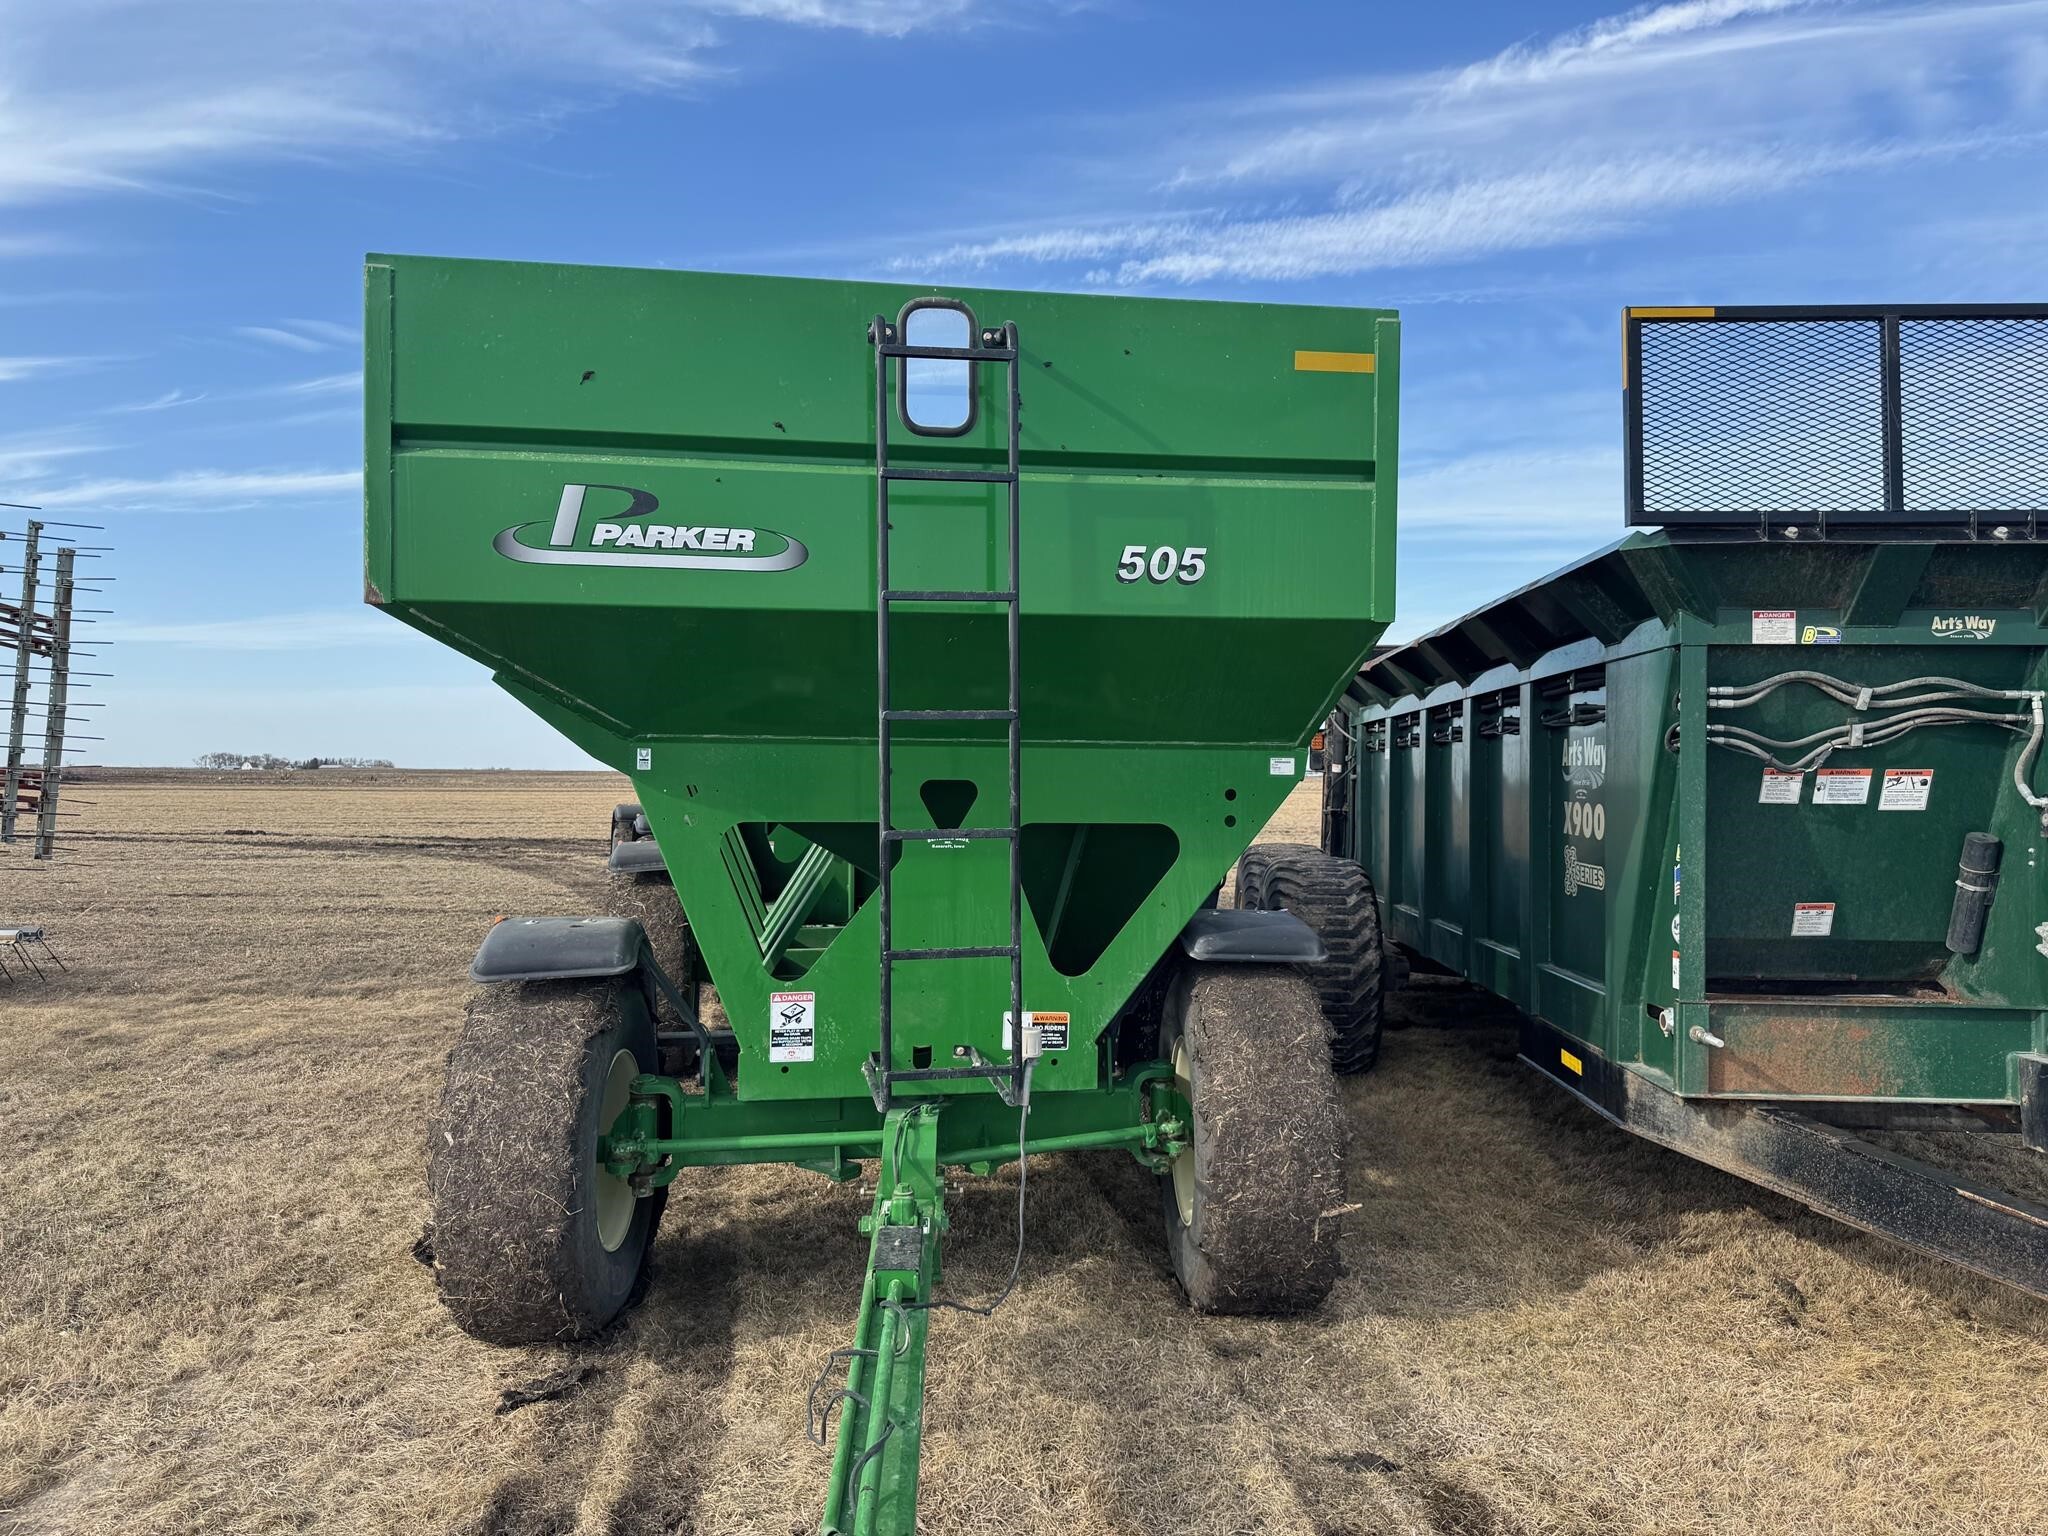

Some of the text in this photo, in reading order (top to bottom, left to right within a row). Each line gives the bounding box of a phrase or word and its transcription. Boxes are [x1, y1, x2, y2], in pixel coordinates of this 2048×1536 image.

[591, 522, 756, 553] PARKER
[1116, 545, 1207, 584] 505
[1931, 615, 1997, 633] Art's Way
[1562, 736, 1607, 773] Art's Way
[1563, 801, 1605, 841] X900
[1575, 864, 1604, 887] SERIES
[782, 994, 813, 1002] DANGER
